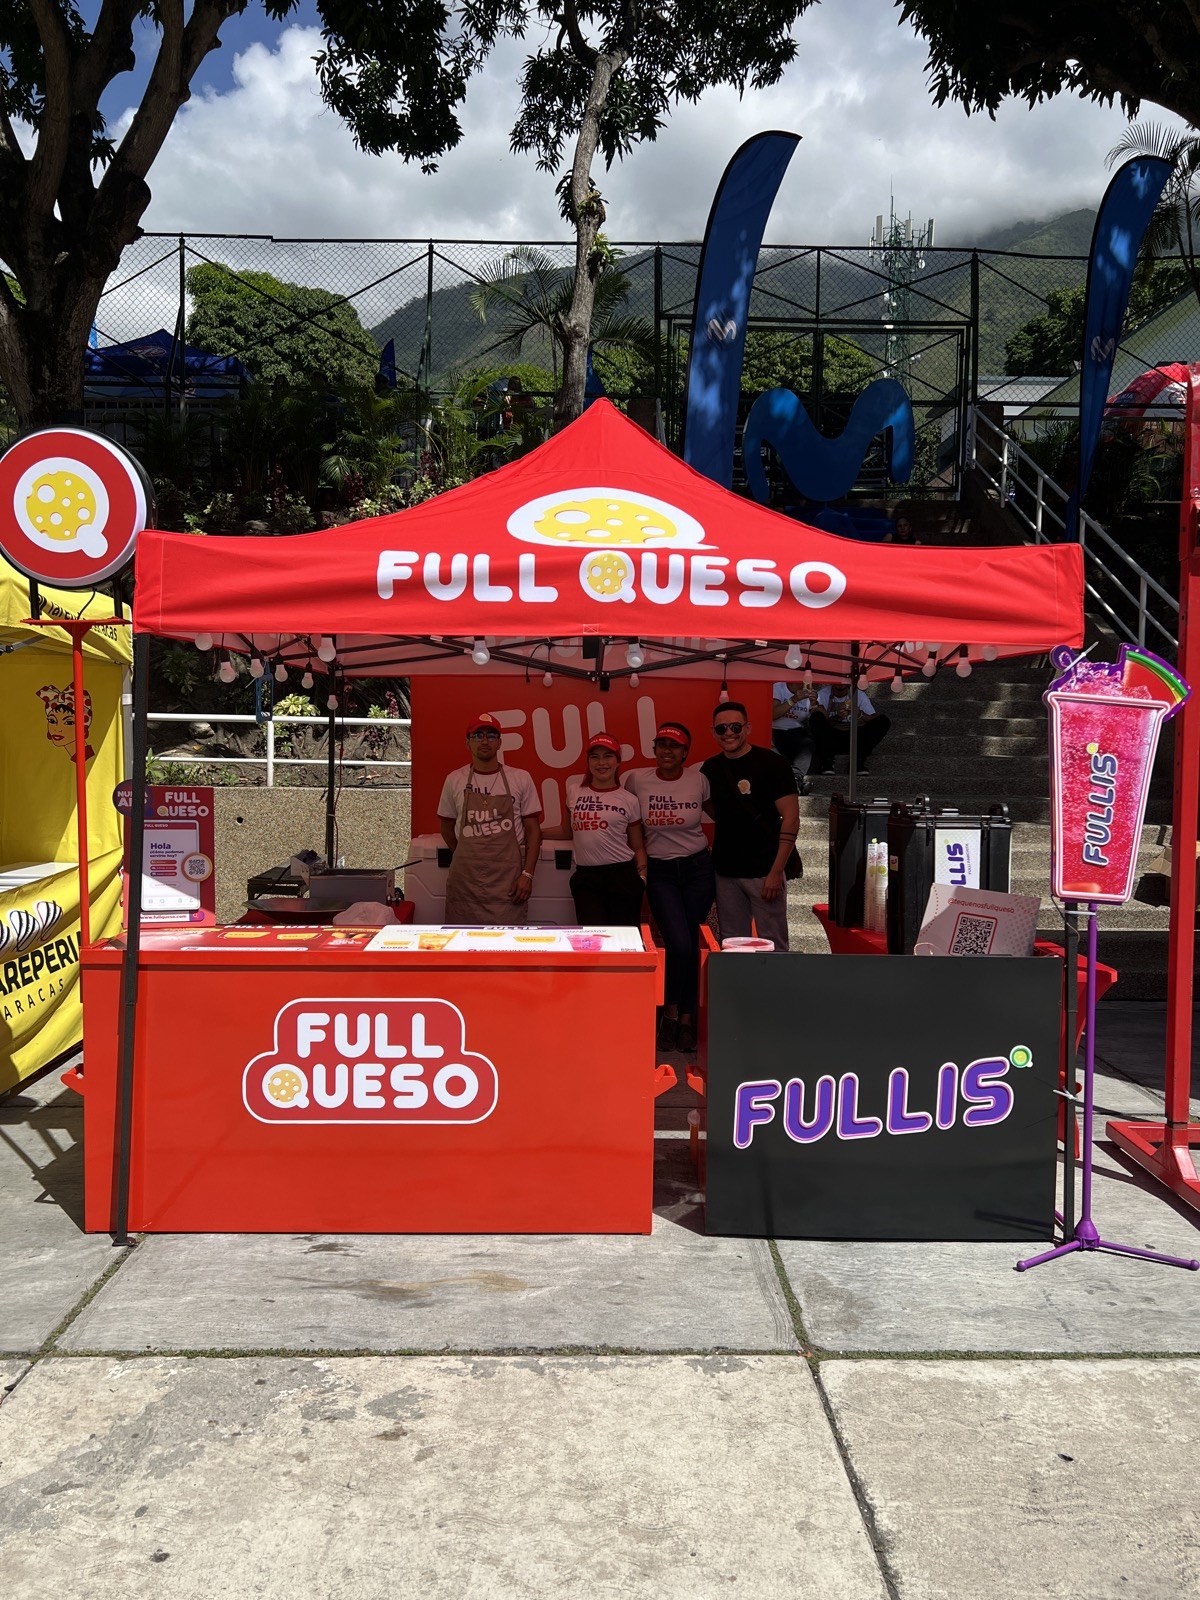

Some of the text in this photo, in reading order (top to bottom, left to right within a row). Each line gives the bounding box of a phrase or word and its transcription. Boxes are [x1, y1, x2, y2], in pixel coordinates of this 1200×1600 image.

[377, 549, 847, 608] FULL QUESO
[165, 792, 200, 804] FULL
[576, 796, 603, 804] FULL
[649, 795, 676, 803] FULL
[157, 805, 209, 817] QUESO
[574, 803, 626, 815] NUESTRO
[649, 802, 698, 810] NUESTRO
[1083, 753, 1118, 867] FULLIS
[467, 808, 502, 823] FULL
[573, 812, 601, 821] FULL
[648, 810, 677, 818] FULL
[572, 820, 609, 831] QUESO
[645, 817, 686, 826] QUESO
[463, 818, 513, 838] QUESO
[150, 842, 172, 850] Hola
[946, 842, 967, 886] LLIS
[0, 931, 81, 996] AREPERI
[297, 1013, 444, 1058] FULL
[262, 1063, 479, 1109] QUESO
[733, 1056, 1014, 1149] FULLIS
